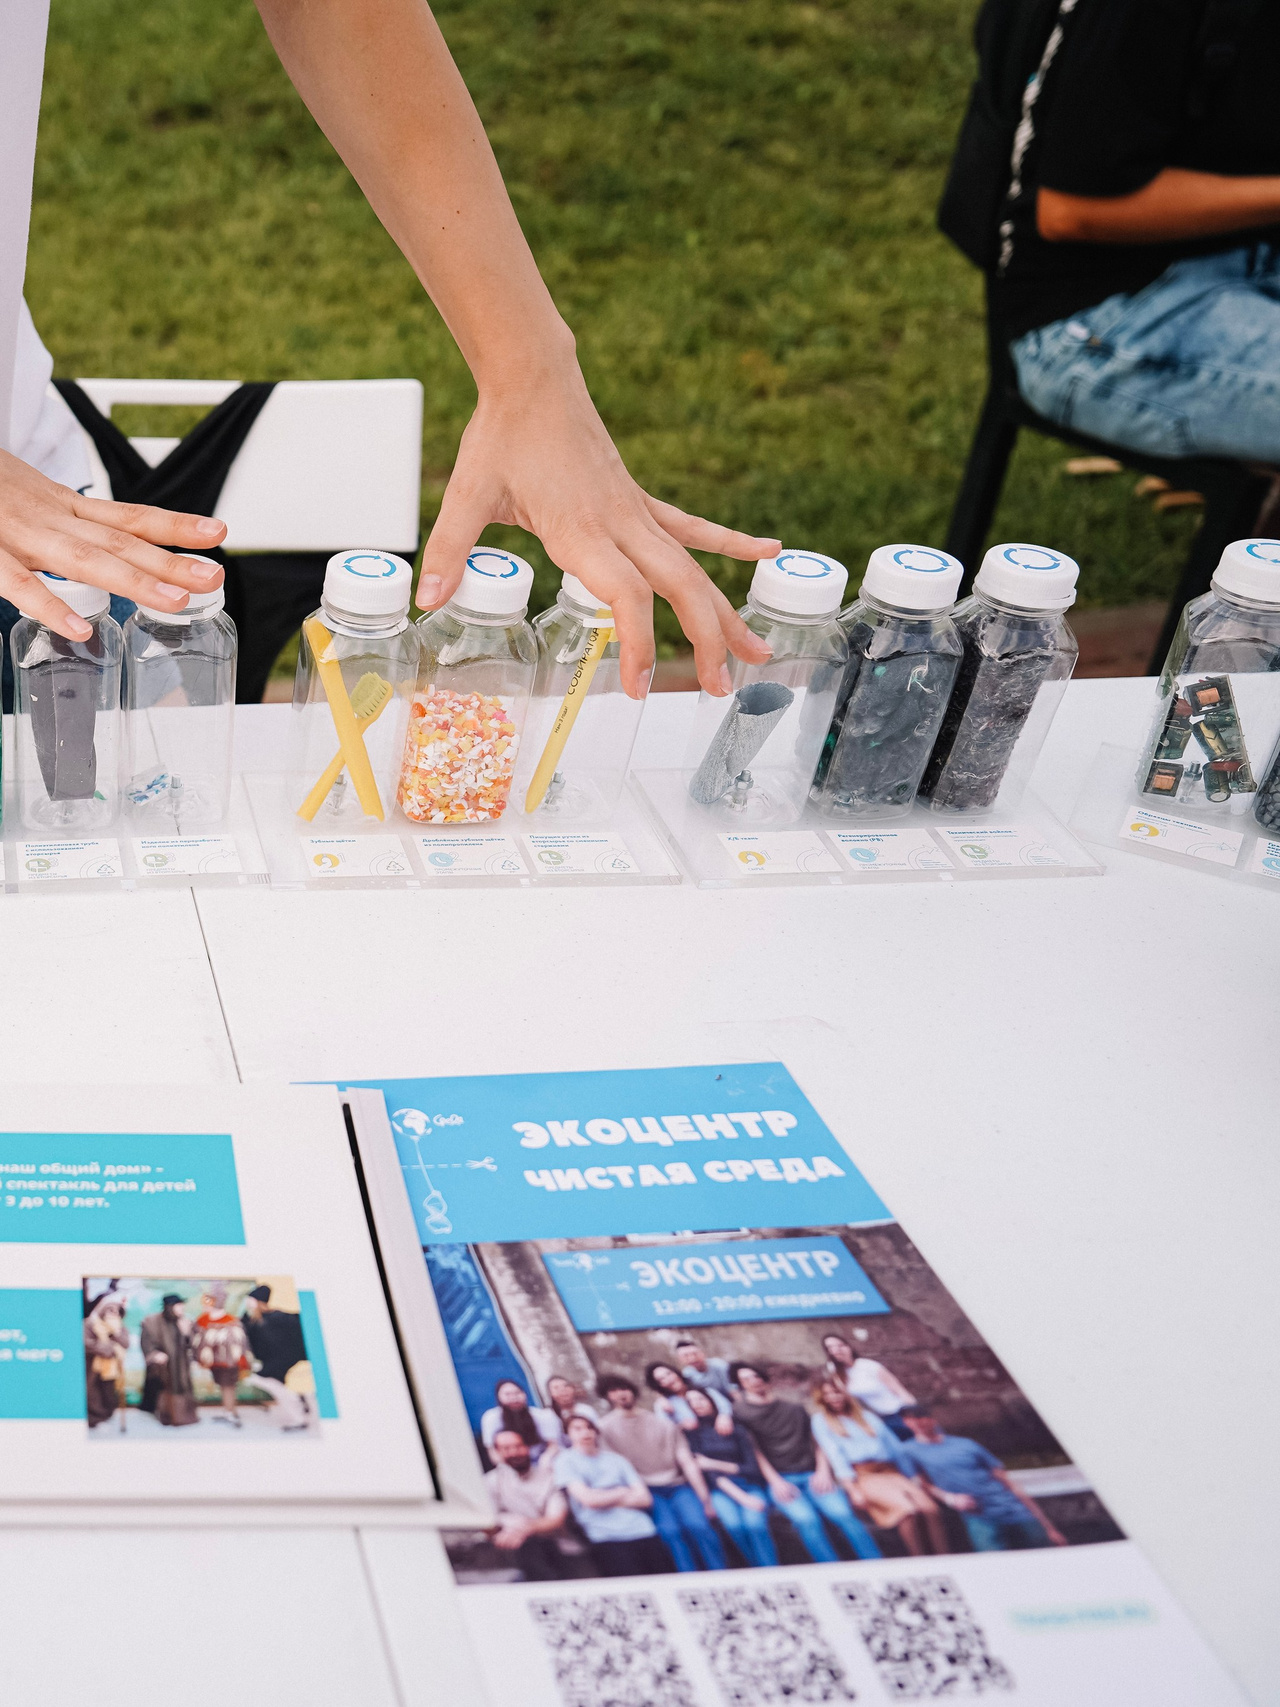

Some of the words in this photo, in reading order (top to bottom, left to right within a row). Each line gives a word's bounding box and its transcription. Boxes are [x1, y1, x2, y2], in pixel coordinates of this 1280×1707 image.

[511, 1110, 798, 1150] ЭКОЦЕНТР
[38, 1160, 101, 1177] общий
[103, 1162, 152, 1177] дом»
[523, 1161, 698, 1193] ЧИСТАЯ
[702, 1155, 847, 1185] СРЕДА
[5, 1178, 101, 1192] спектакль
[102, 1179, 139, 1193] для
[140, 1178, 197, 1194] детей
[5, 1194, 17, 1208] 3
[18, 1194, 44, 1210] до
[46, 1195, 70, 1208] 10
[72, 1195, 111, 1209] лет.
[629, 1250, 840, 1289] ЭКОЦЕНТР
[651, 1297, 703, 1316] 12:00
[14, 1347, 64, 1363] чего
